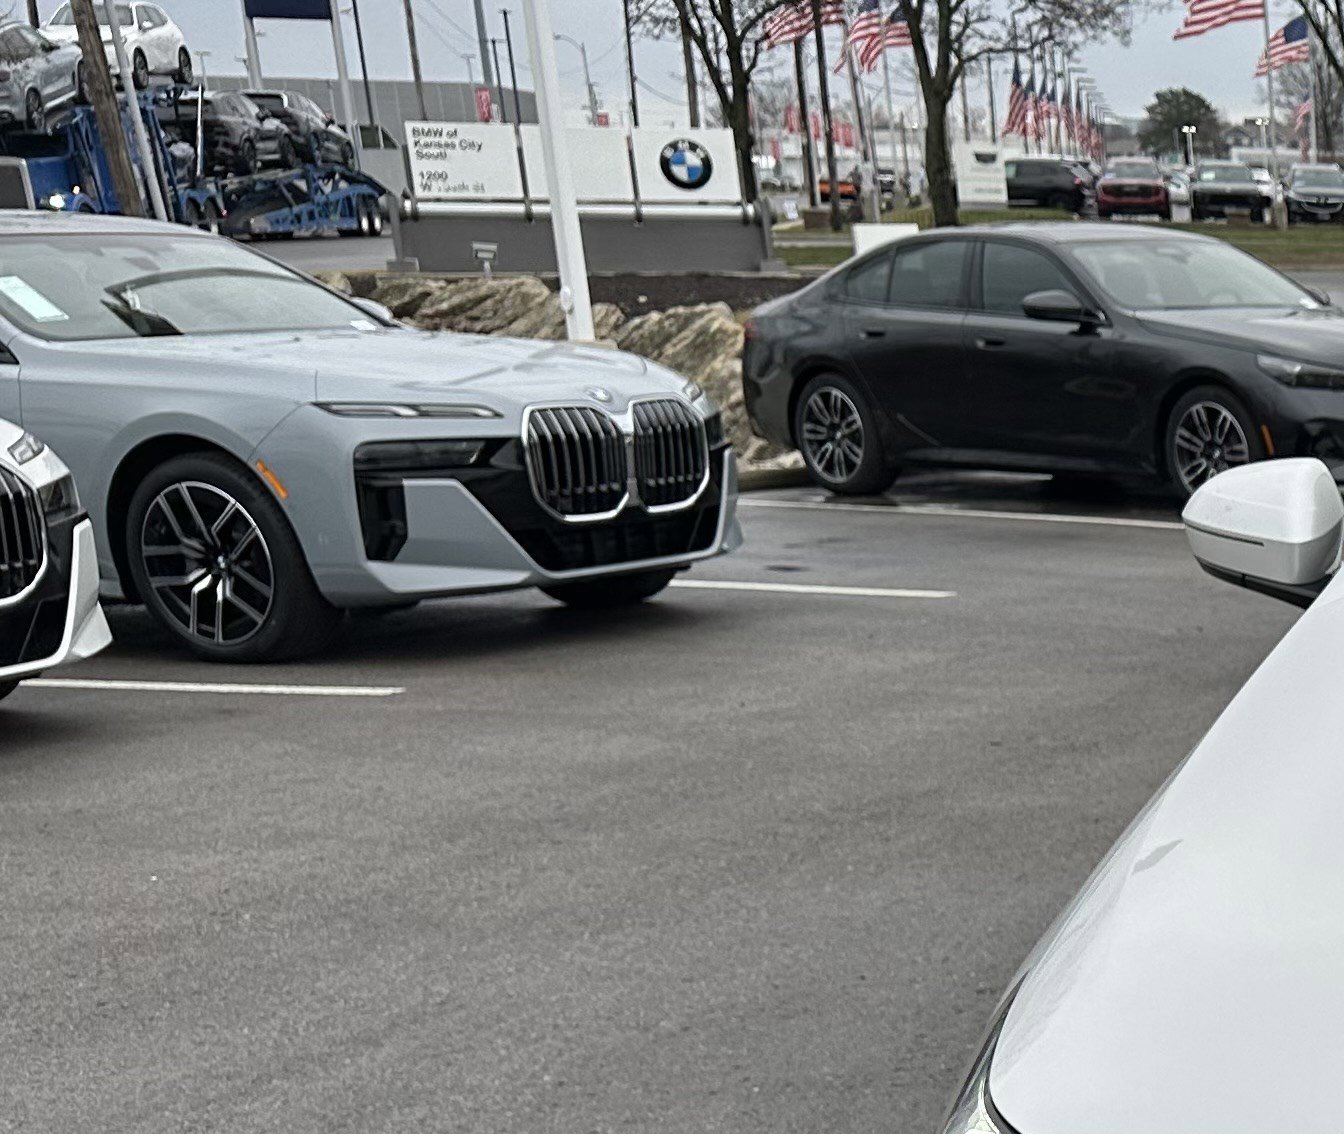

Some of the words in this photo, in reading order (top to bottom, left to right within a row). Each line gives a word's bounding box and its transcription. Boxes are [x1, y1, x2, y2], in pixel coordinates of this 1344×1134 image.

[412, 126, 443, 138] BMW
[446, 128, 458, 139] of
[414, 139, 457, 150] Kansas
[459, 138, 483, 153] City
